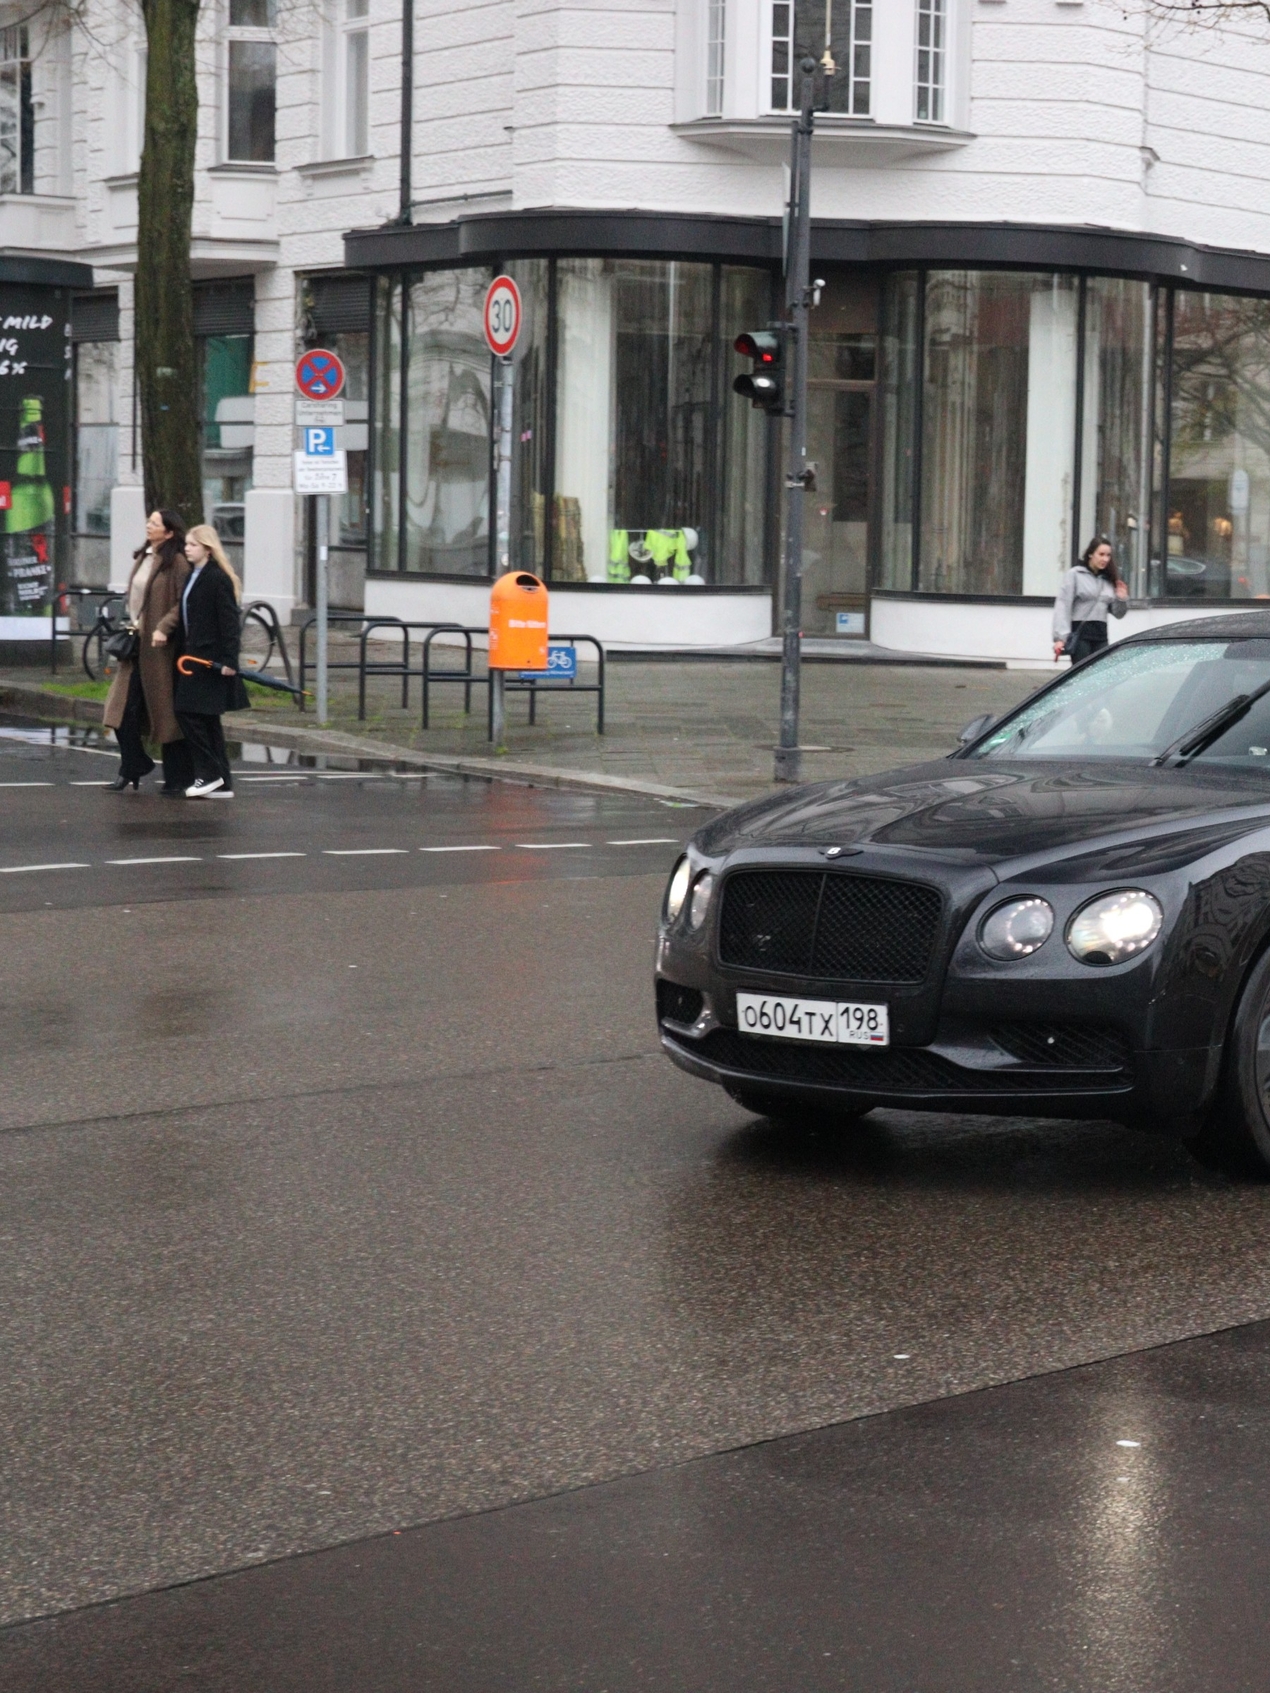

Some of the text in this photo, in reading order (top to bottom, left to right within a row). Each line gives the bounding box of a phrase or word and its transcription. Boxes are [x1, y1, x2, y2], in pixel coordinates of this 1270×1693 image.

[3, 314, 53, 329] MILD
[492, 299, 512, 333] 30
[309, 429, 326, 453] P
[840, 1006, 878, 1031] 198
[849, 1030, 869, 1040] RUS
